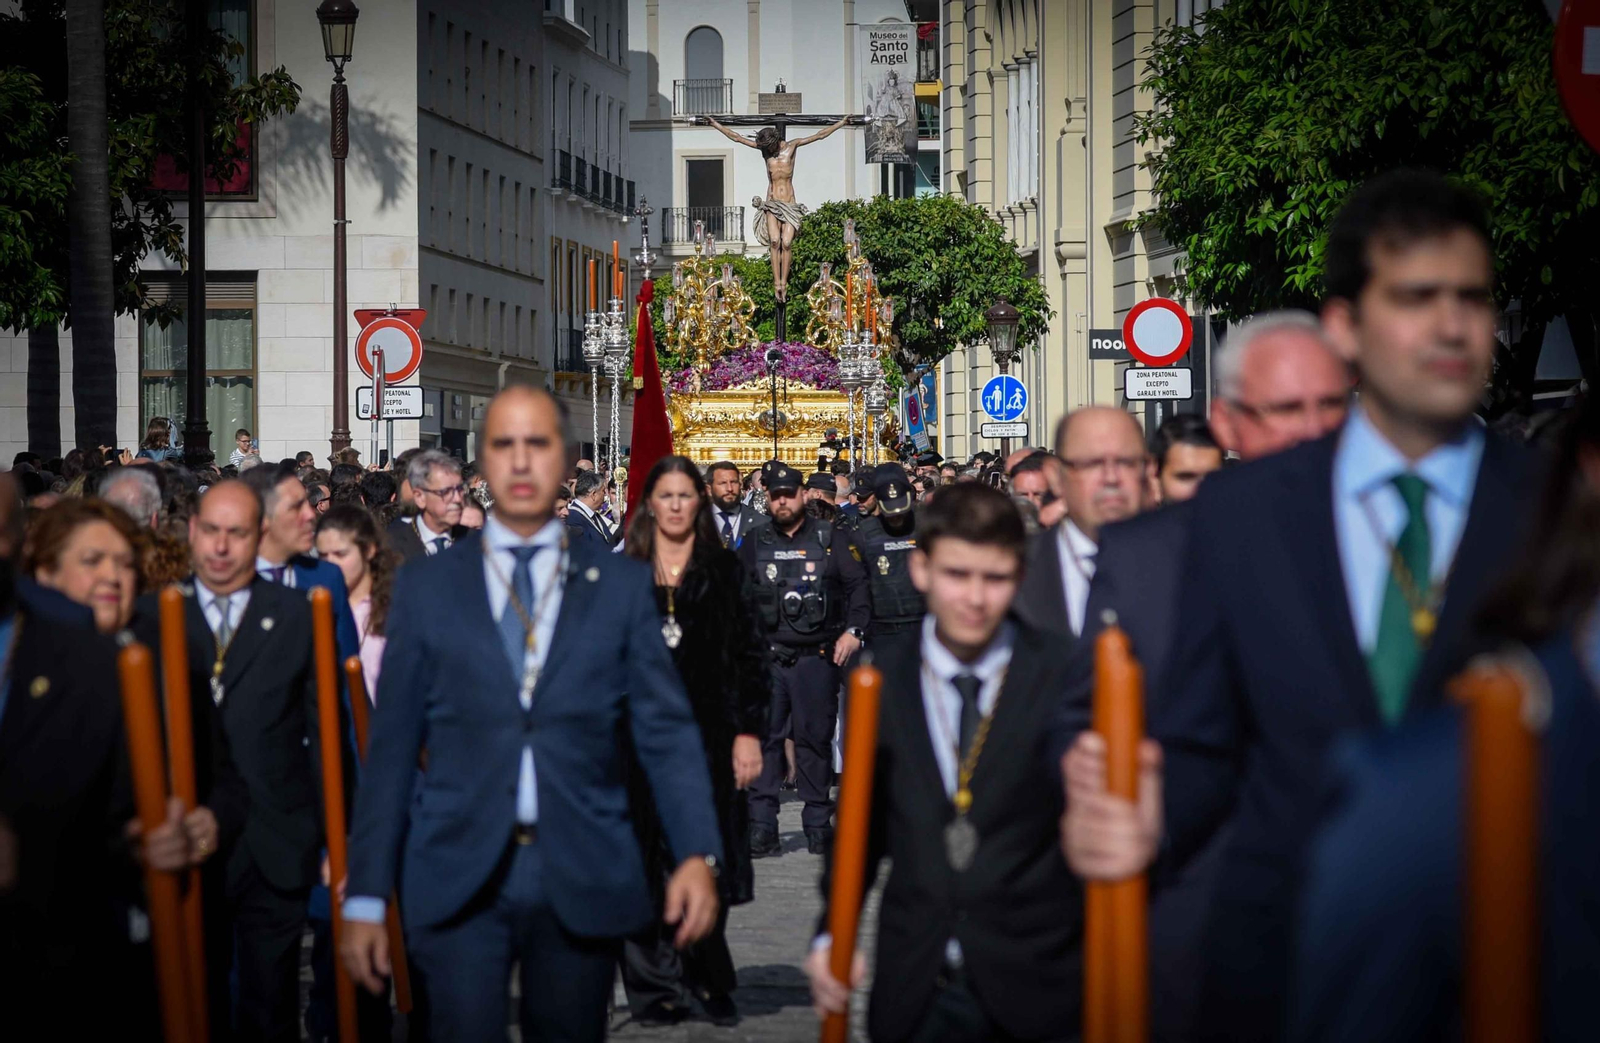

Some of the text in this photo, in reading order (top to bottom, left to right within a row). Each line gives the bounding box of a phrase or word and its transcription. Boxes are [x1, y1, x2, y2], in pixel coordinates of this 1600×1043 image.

[870, 31, 897, 39] Museo
[870, 40, 909, 51] Santo
[1146, 380, 1169, 388] EXCEPTO
